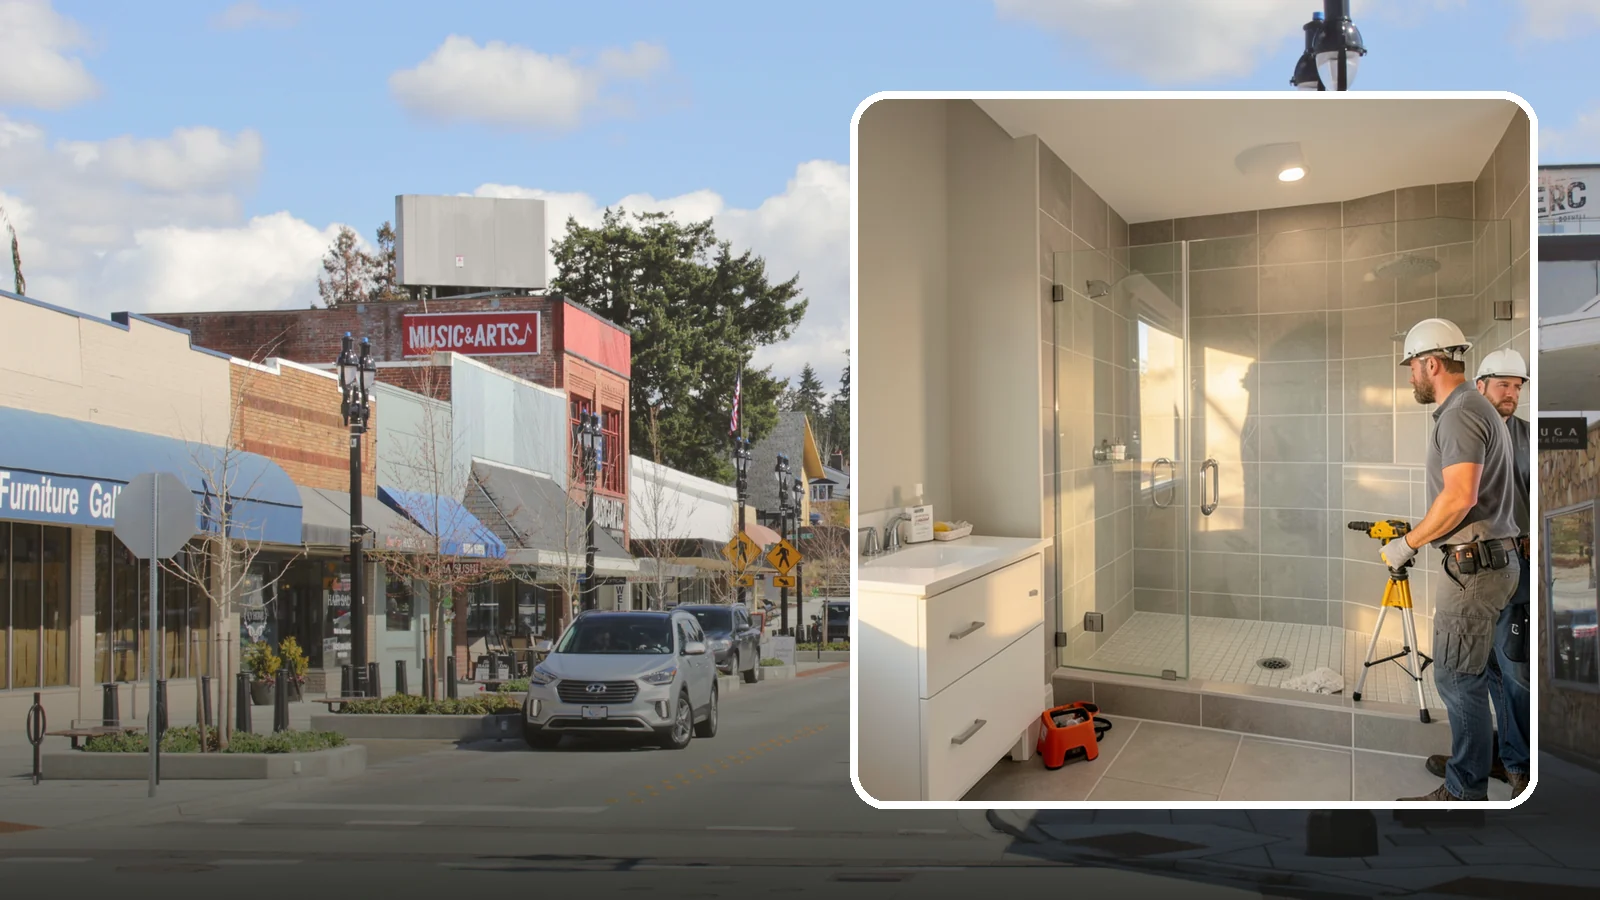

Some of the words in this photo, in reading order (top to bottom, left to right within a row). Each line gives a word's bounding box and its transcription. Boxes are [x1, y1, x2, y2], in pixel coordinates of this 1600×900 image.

[409, 323, 519, 348] MUSIC&ARTS
[1541, 428, 1577, 436] UGA
[0, 472, 79, 515] Furniture
[89, 482, 121, 519] Gal
[453, 563, 479, 574] SUSHI
